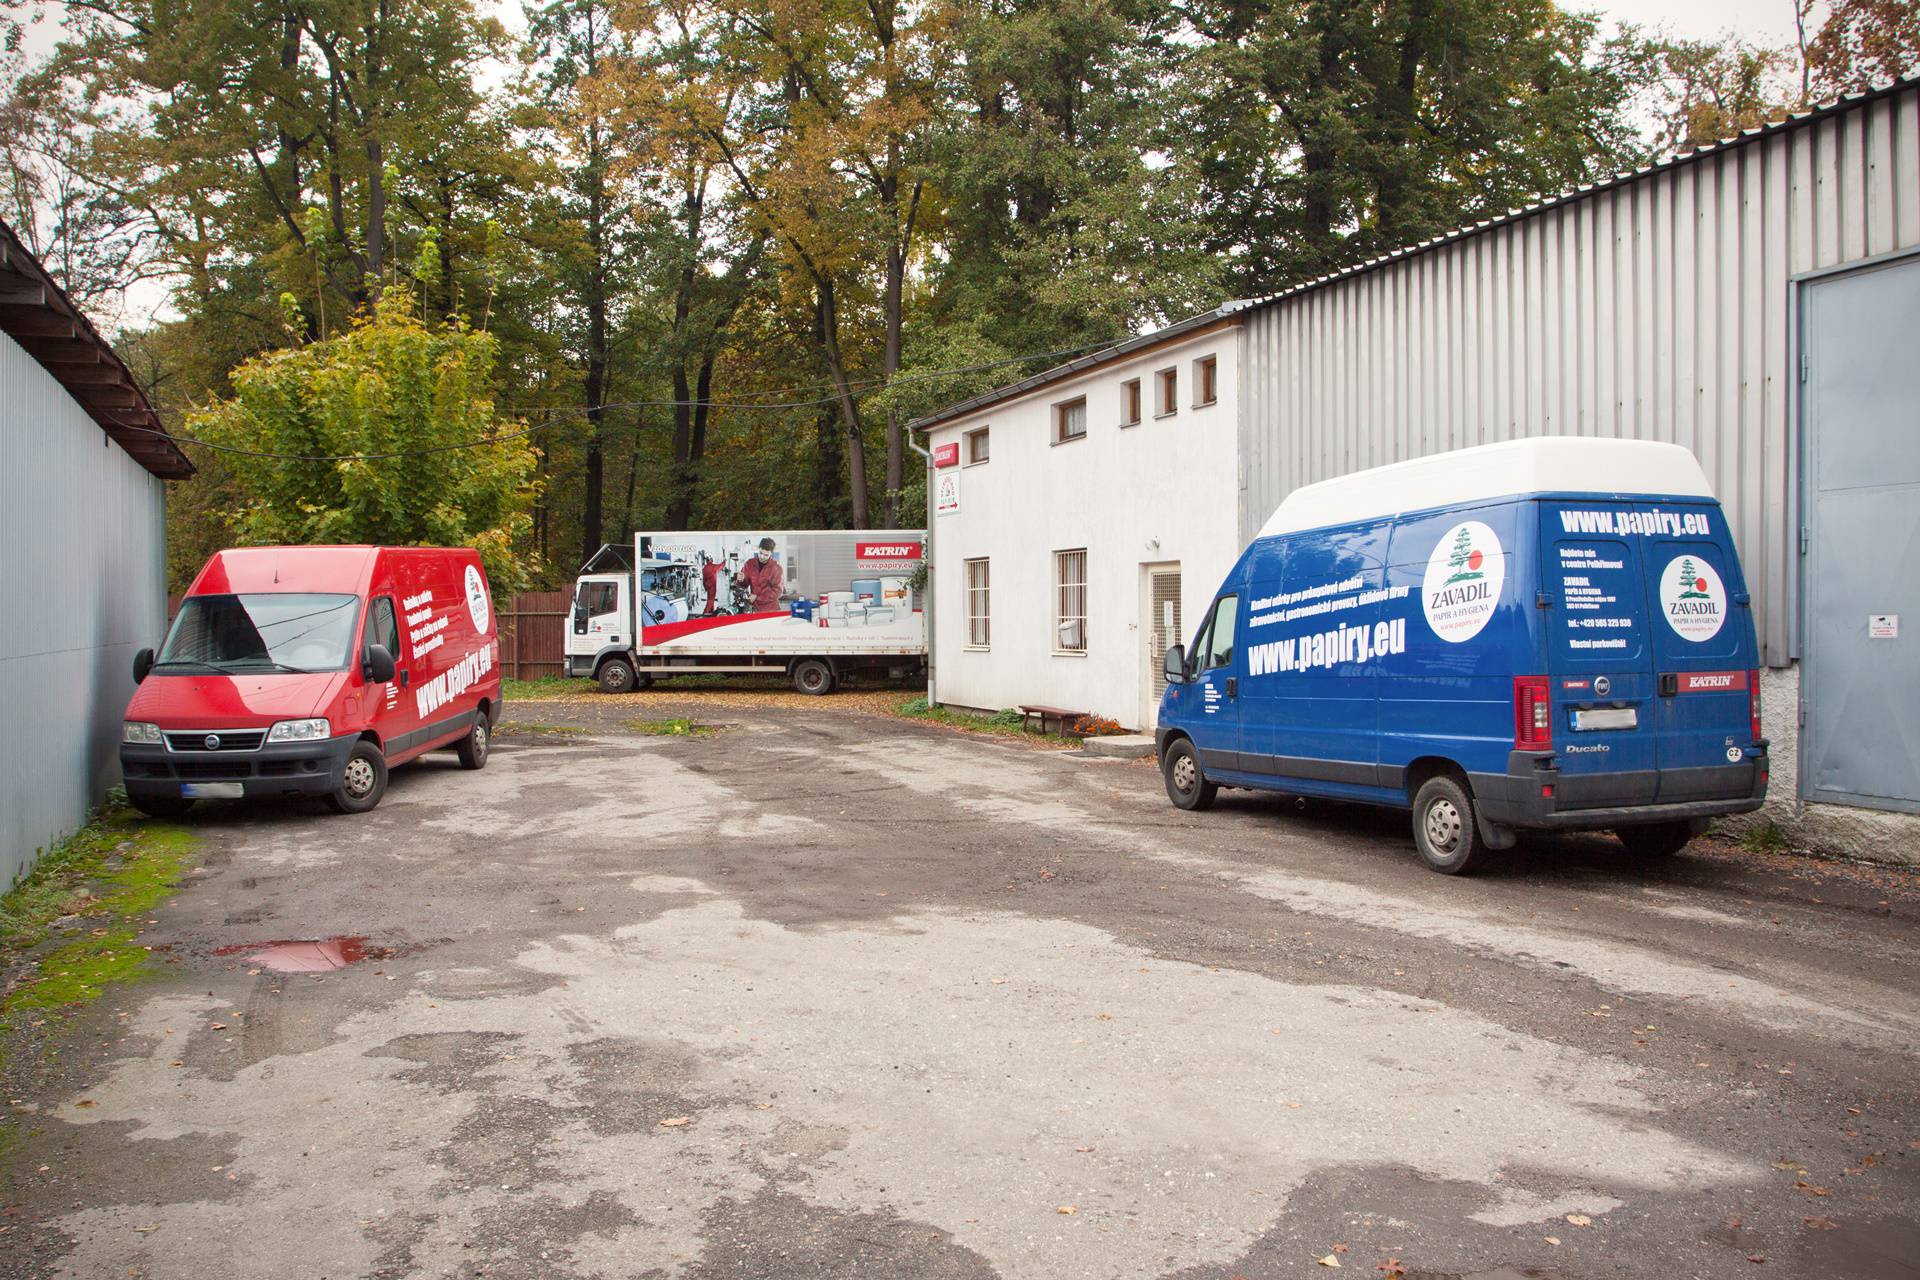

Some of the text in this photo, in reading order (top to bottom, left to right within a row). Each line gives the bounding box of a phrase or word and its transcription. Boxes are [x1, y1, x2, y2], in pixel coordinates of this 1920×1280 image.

[1560, 508, 1710, 536] www.papiry.eu
[864, 547, 909, 556] KATRIN
[857, 562, 912, 570] www.papiry.eu
[1431, 582, 1492, 609] ZAVADIL
[1459, 603, 1489, 617] HYGIENA
[1670, 602, 1719, 615] ZAVADIL
[1248, 618, 1405, 676] www.papiry.eu
[416, 643, 492, 720] www.papiry.eu
[1689, 676, 1731, 688] KATRIN
[1566, 744, 1611, 753] Ducato
[1729, 749, 1740, 757] CZ
